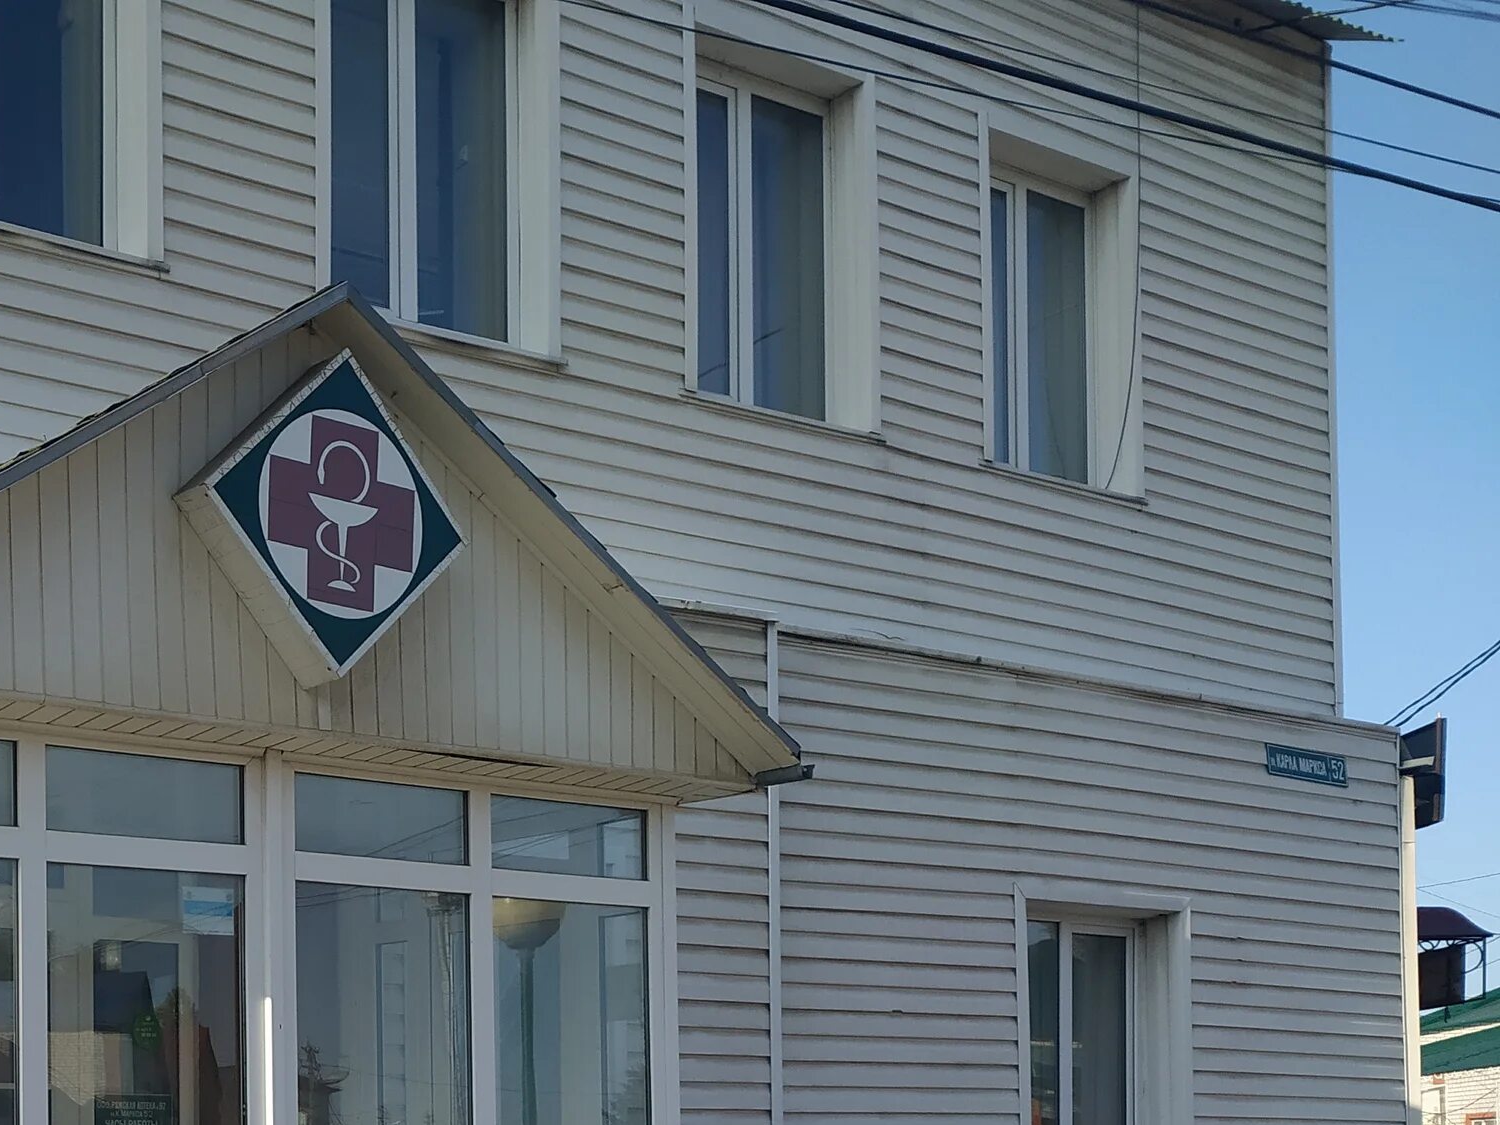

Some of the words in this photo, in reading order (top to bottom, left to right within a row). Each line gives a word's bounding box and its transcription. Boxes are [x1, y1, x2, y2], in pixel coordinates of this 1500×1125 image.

[1276, 753, 1299, 771] КАРЛА
[1299, 757, 1328, 776] МАРКСА
[1331, 760, 1345, 780] 52
